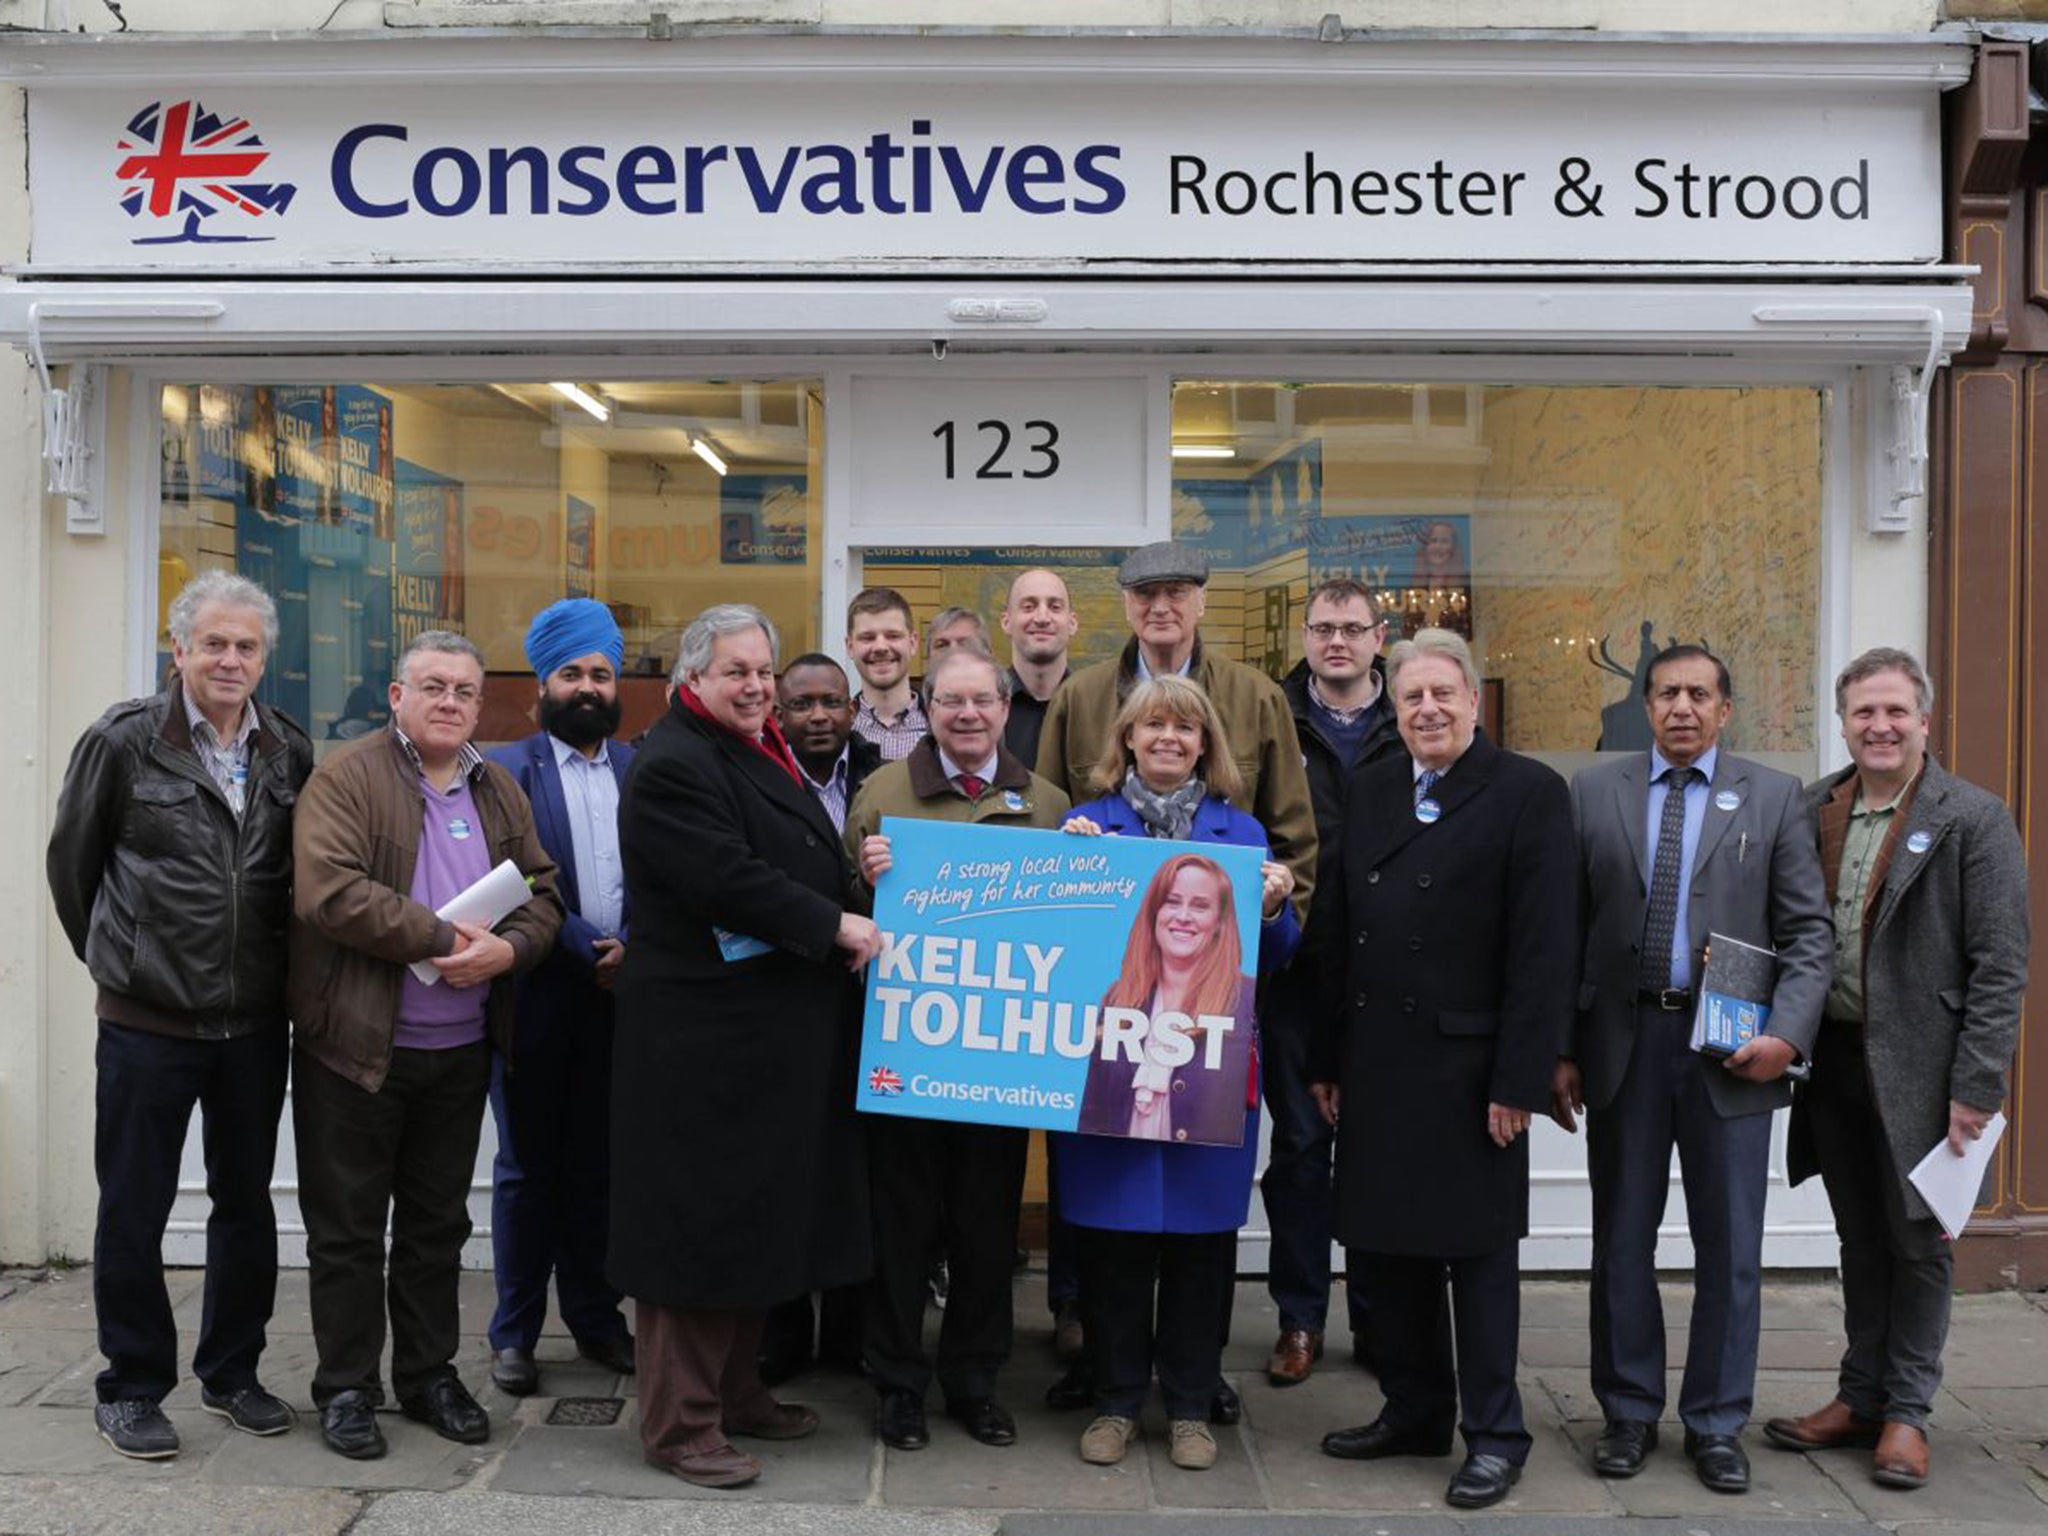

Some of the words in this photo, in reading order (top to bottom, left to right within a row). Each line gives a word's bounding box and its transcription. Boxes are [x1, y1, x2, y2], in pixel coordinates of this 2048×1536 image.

[331, 120, 1126, 218] Conservatives
[1170, 151, 1525, 217] Rochester
[1553, 157, 1604, 218] &
[1635, 158, 1870, 220] Strood
[340, 435, 371, 468] KELLY
[932, 420, 1061, 480] 123
[398, 574, 437, 613] KELLY
[937, 862, 952, 881] A
[958, 861, 1011, 884] strong
[1020, 854, 1062, 876] local
[1069, 855, 1110, 876] voice,
[981, 878, 1008, 906] for
[1013, 879, 1043, 901] her
[1049, 876, 1137, 899] community
[876, 930, 1065, 994] KELLY
[875, 987, 1235, 1070] TOLHURST
[910, 1074, 1076, 1109] Conservatives
